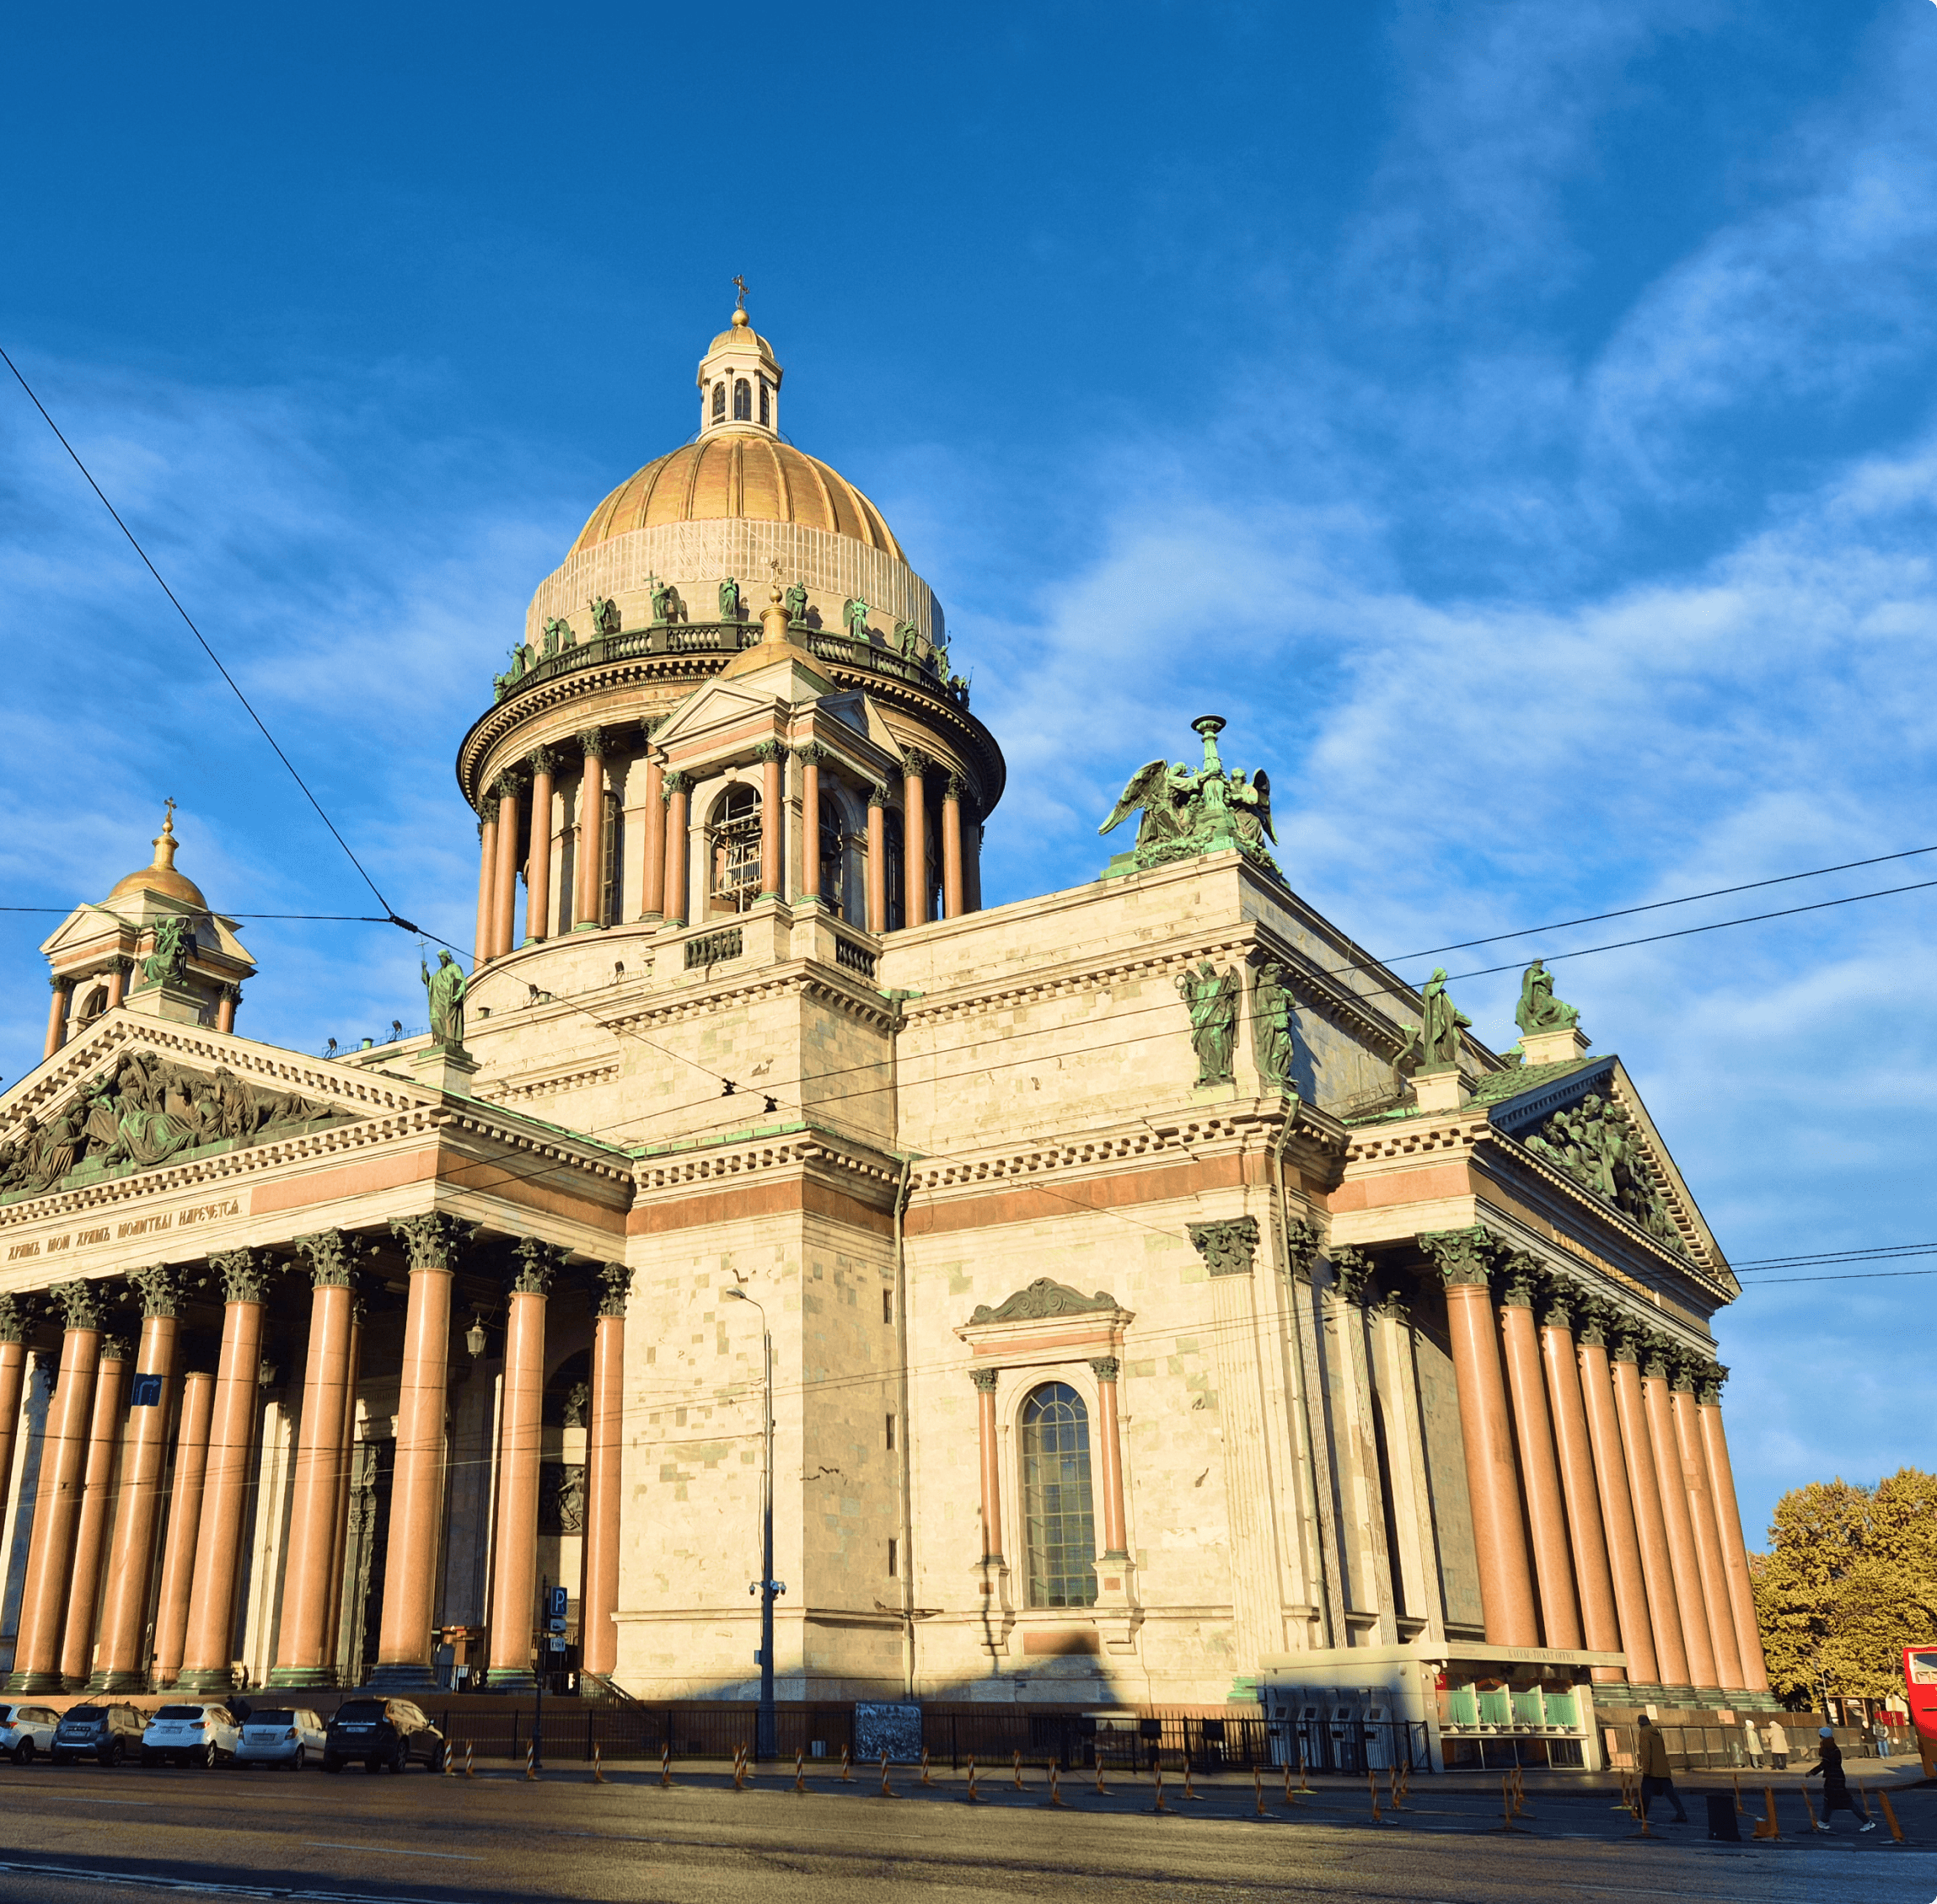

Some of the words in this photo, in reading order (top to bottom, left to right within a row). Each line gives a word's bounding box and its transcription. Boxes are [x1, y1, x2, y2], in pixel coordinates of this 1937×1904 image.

[555, 1590, 565, 1612] P
[1533, 1649, 1553, 1660] TICKET
[1555, 1651, 1575, 1661] OFFICE
